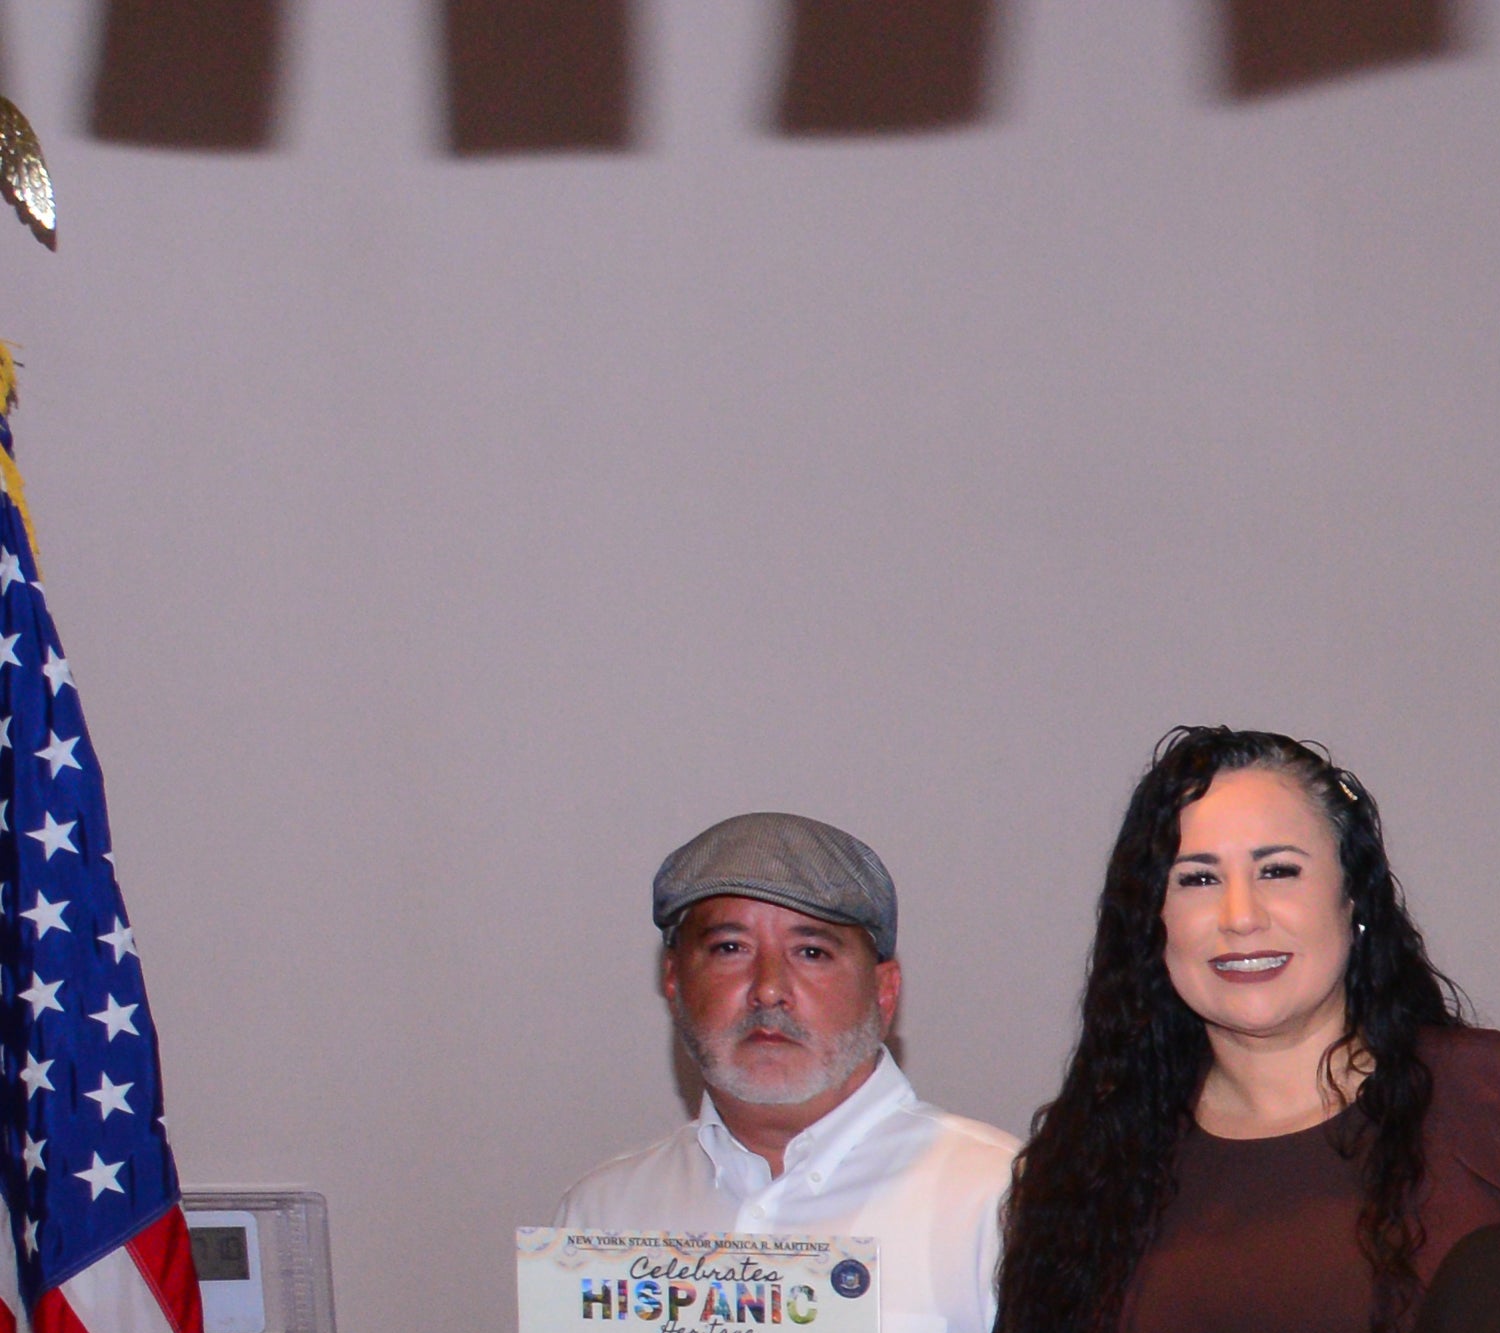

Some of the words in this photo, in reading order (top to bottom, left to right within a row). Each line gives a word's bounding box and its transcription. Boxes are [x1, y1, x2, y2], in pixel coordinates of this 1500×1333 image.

[567, 1235, 593, 1245] NEW
[596, 1236, 626, 1245] YORK
[628, 1237, 660, 1247] STATE
[662, 1238, 711, 1248] SENATOR
[713, 1239, 758, 1250] MONICA
[774, 1241, 830, 1251] MARTINEZ
[630, 1255, 780, 1282] Celebrates
[582, 1278, 817, 1324] HISPANIC
